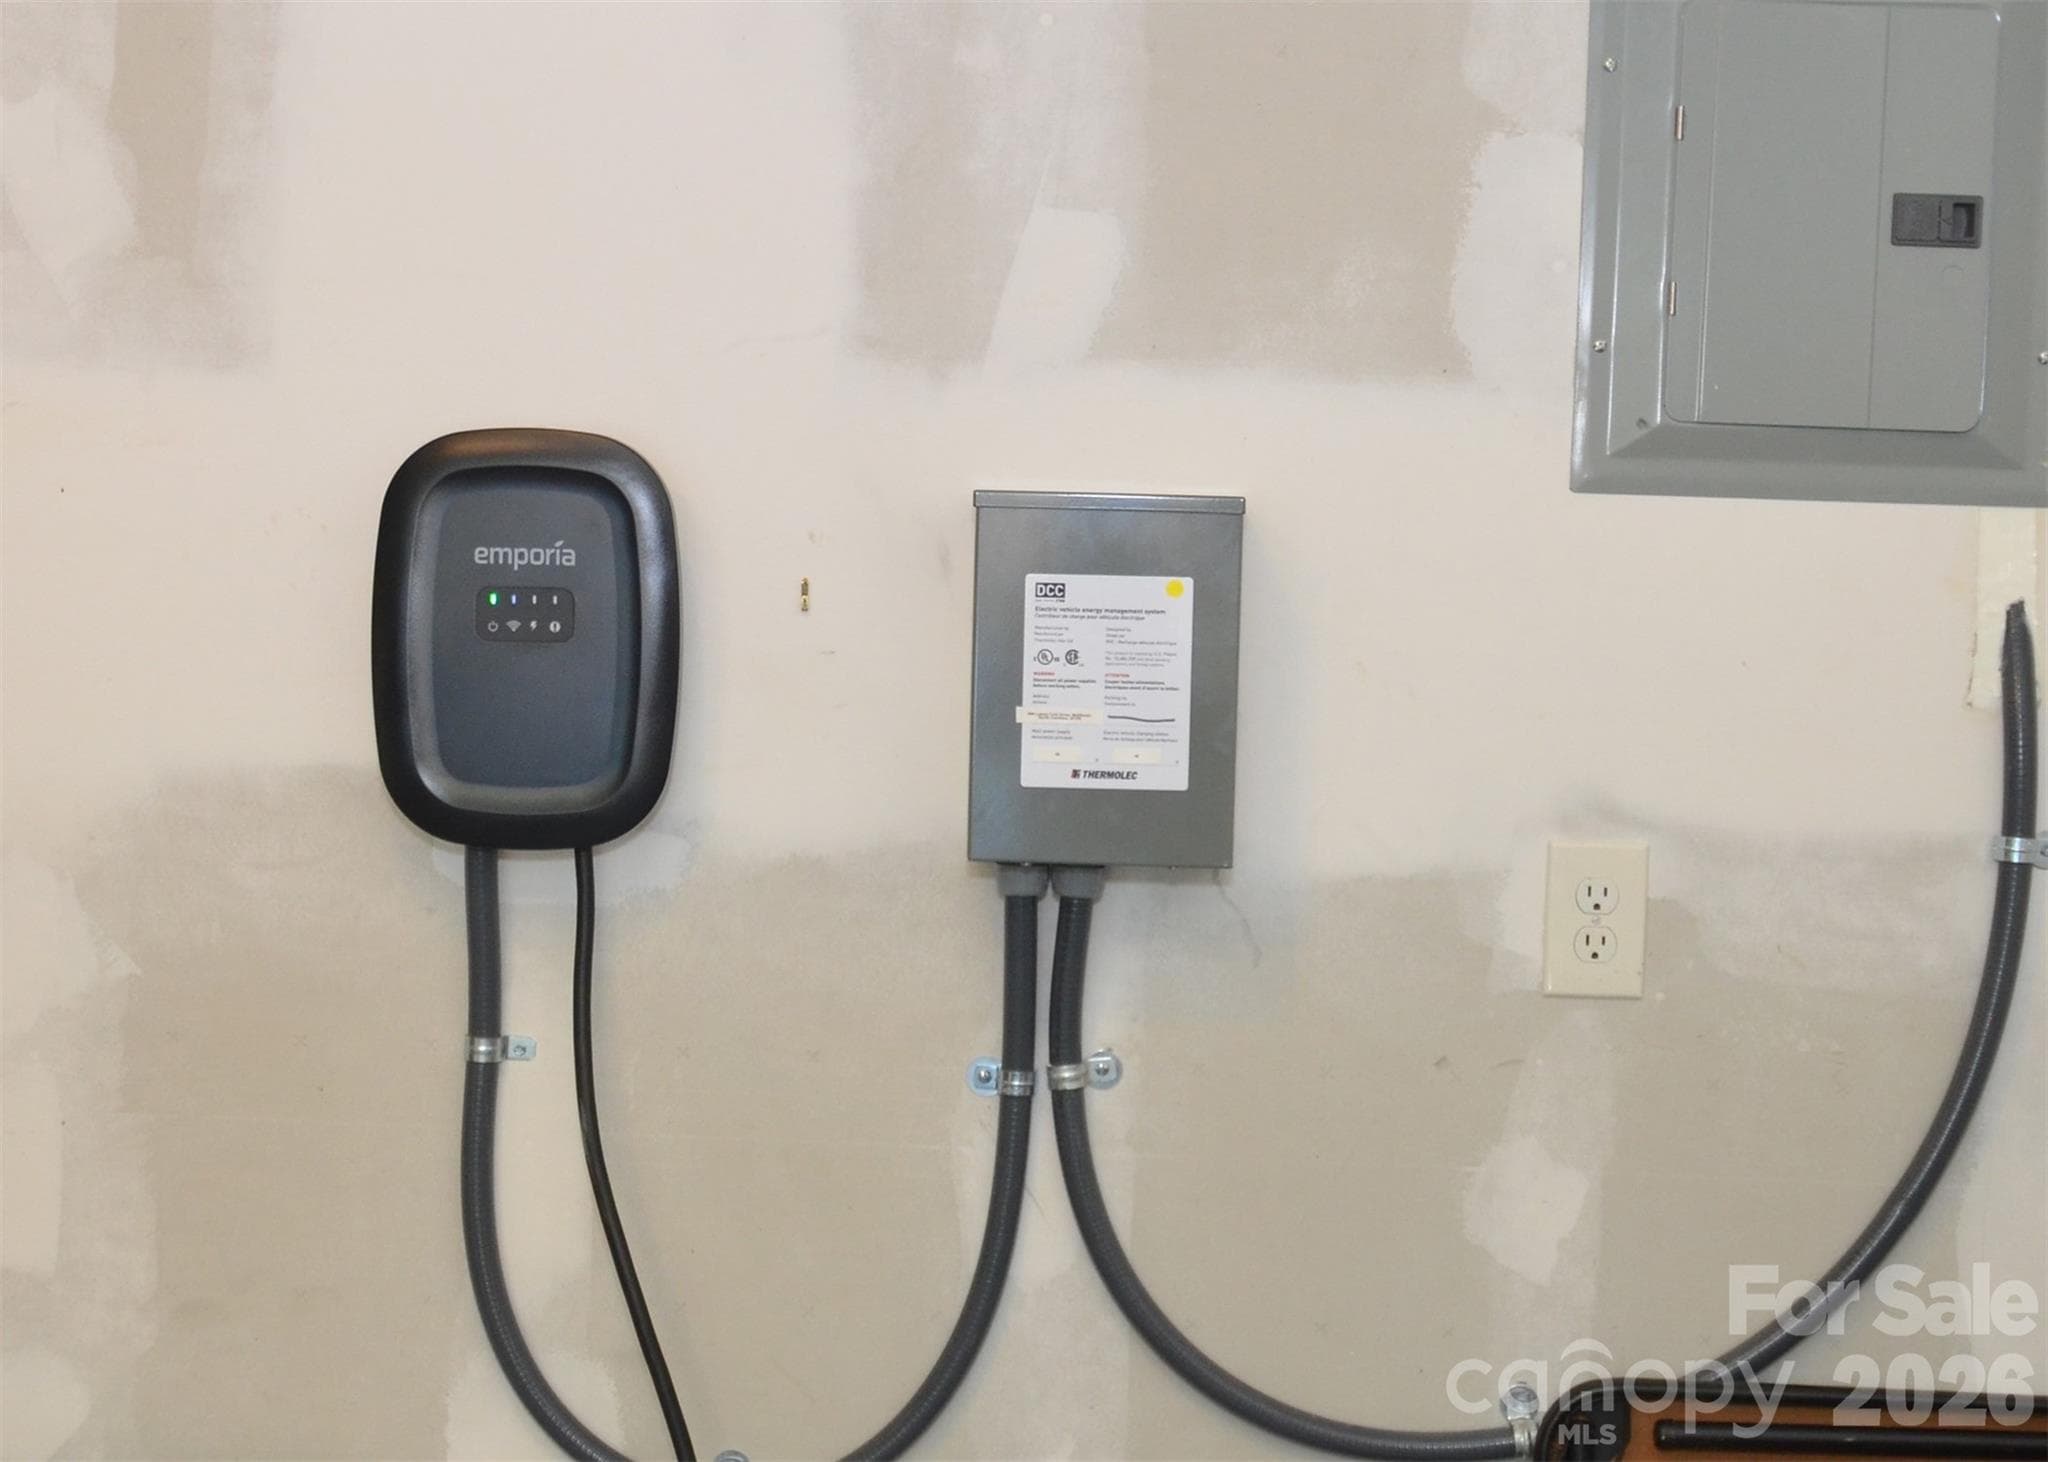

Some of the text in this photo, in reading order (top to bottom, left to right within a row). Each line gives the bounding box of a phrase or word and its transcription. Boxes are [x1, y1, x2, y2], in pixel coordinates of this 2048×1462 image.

[474, 540, 576, 571] emporia
[1036, 584, 1065, 597] DCC
[1083, 770, 1138, 780] THERMOLEC
